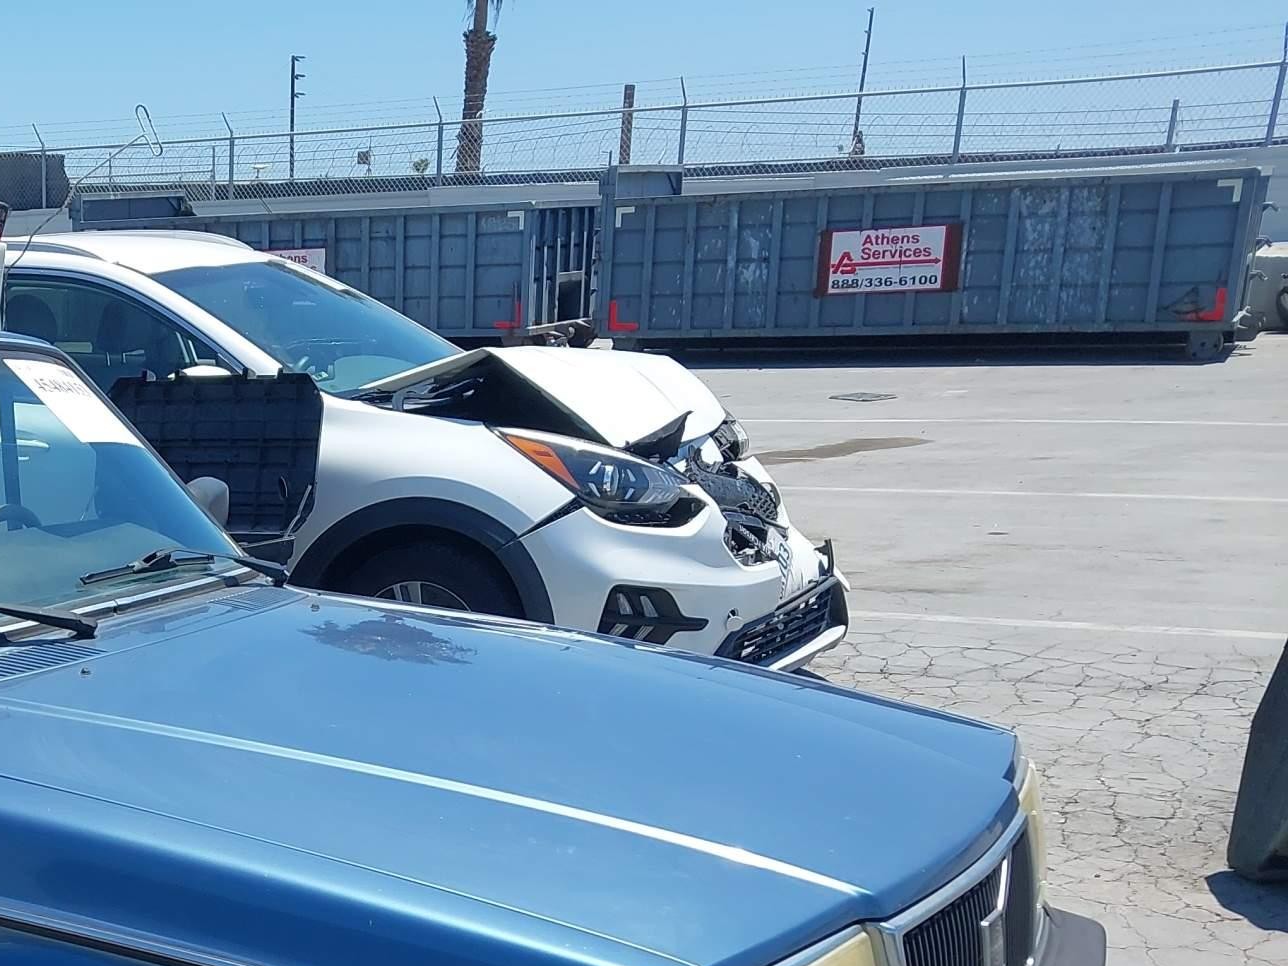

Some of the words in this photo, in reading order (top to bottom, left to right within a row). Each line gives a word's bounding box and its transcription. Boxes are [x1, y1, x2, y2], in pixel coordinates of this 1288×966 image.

[861, 233, 921, 246] Athens
[860, 246, 932, 261] Services
[831, 274, 938, 289] 888/336-6100
